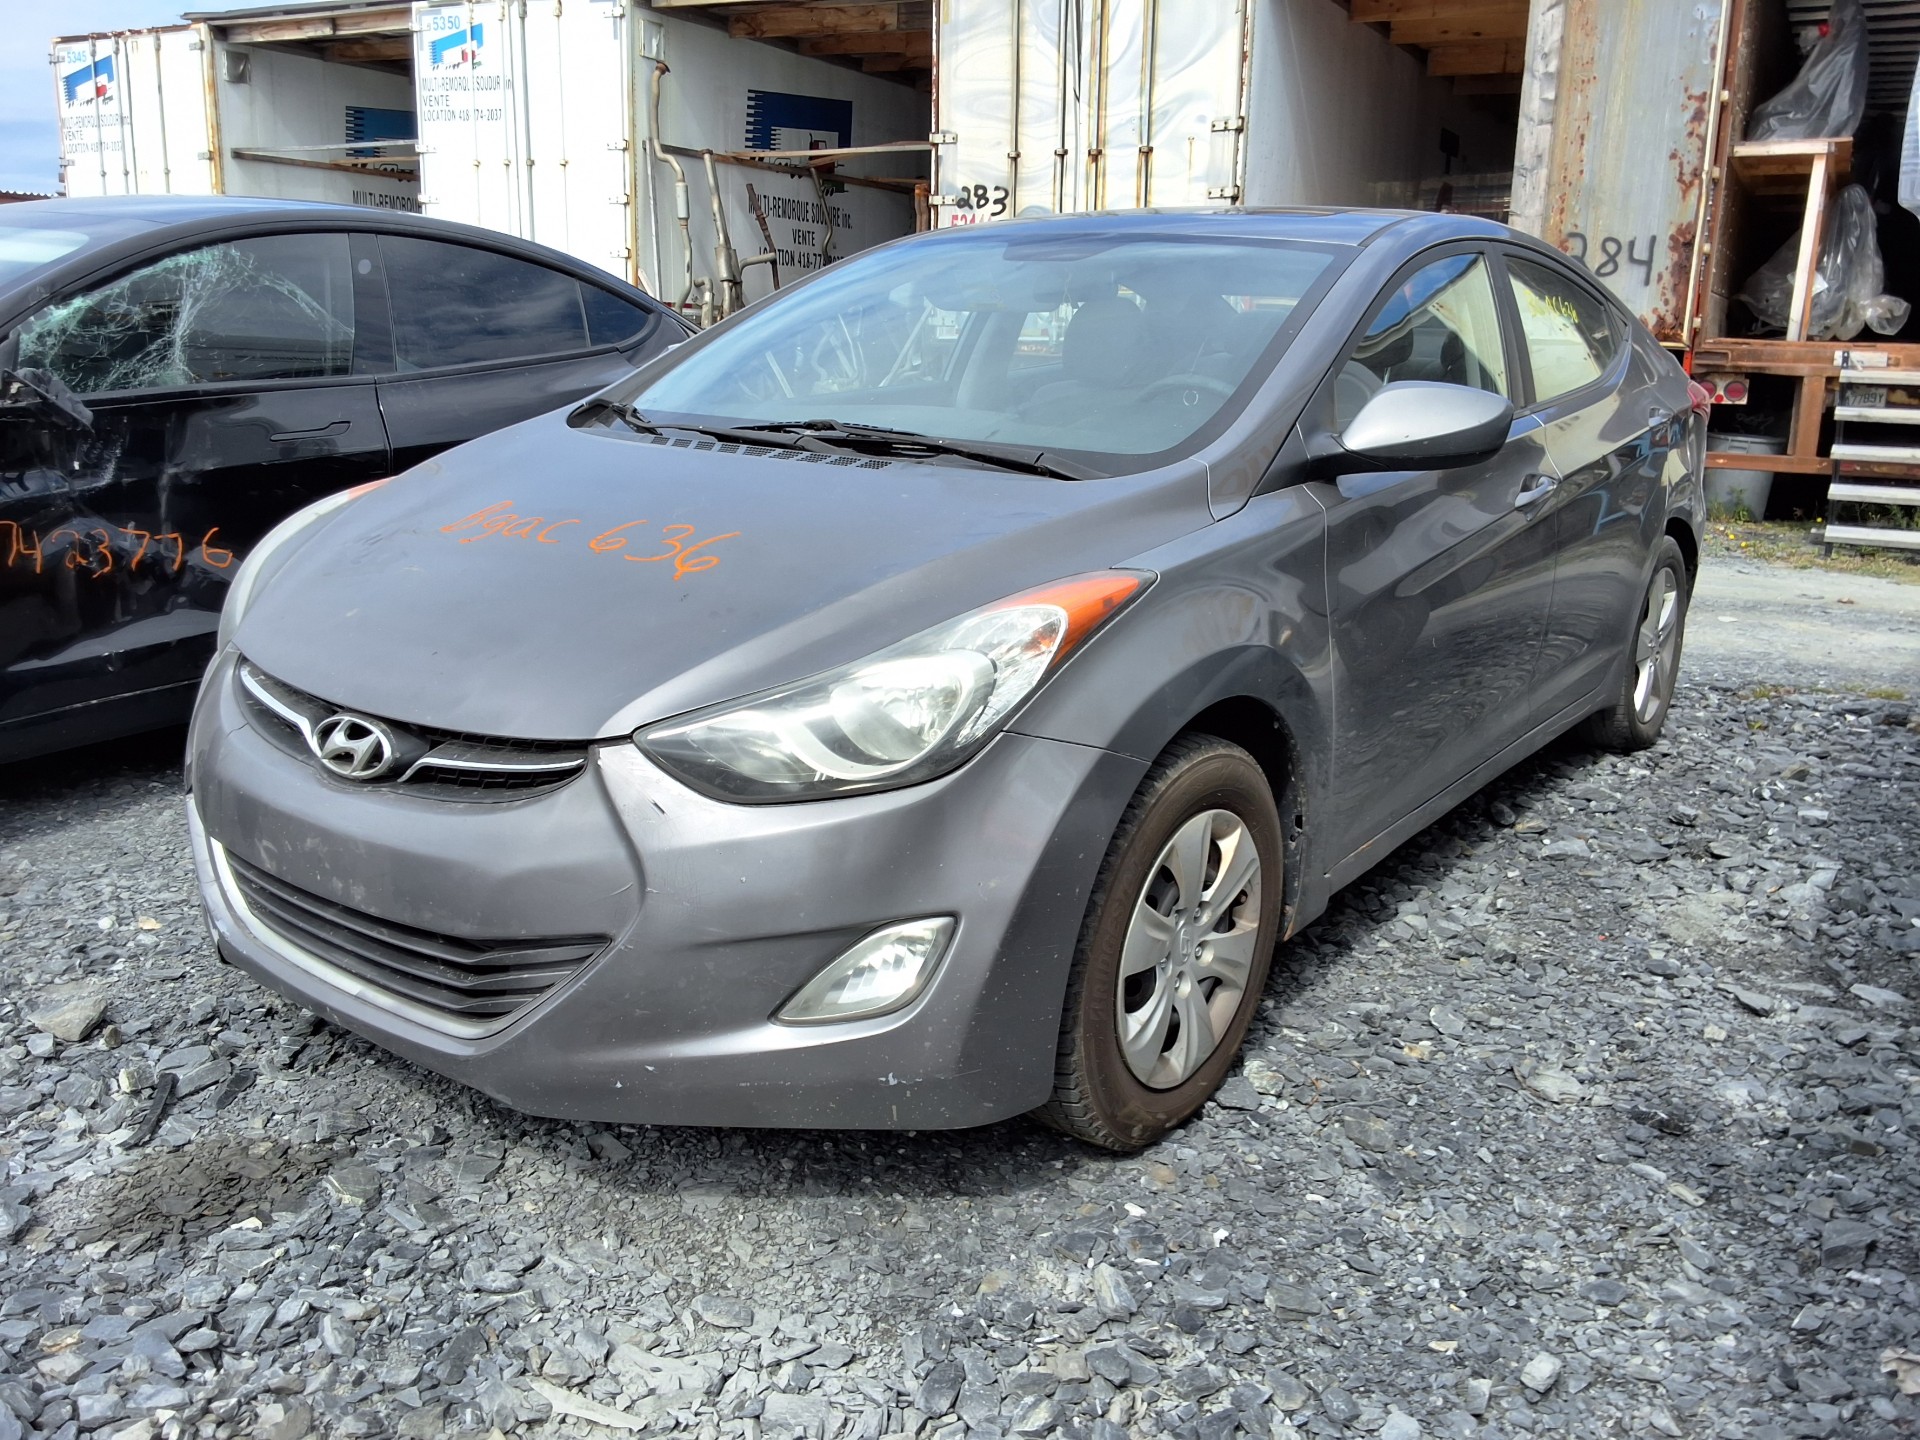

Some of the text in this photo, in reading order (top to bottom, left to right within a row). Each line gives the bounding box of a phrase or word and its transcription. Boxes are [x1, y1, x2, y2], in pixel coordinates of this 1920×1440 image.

[432, 15, 460, 31] 5350
[66, 51, 87, 64] 5345
[423, 94, 450, 107] VENTE
[423, 108, 502, 122] LOCATION 418-74-2037
[63, 129, 83, 141] VENTE
[956, 184, 1010, 217] 283
[841, 208, 853, 230] inc.
[792, 228, 815, 247] VENTE
[1566, 231, 1657, 287] 284
[588, 519, 742, 580] 636
